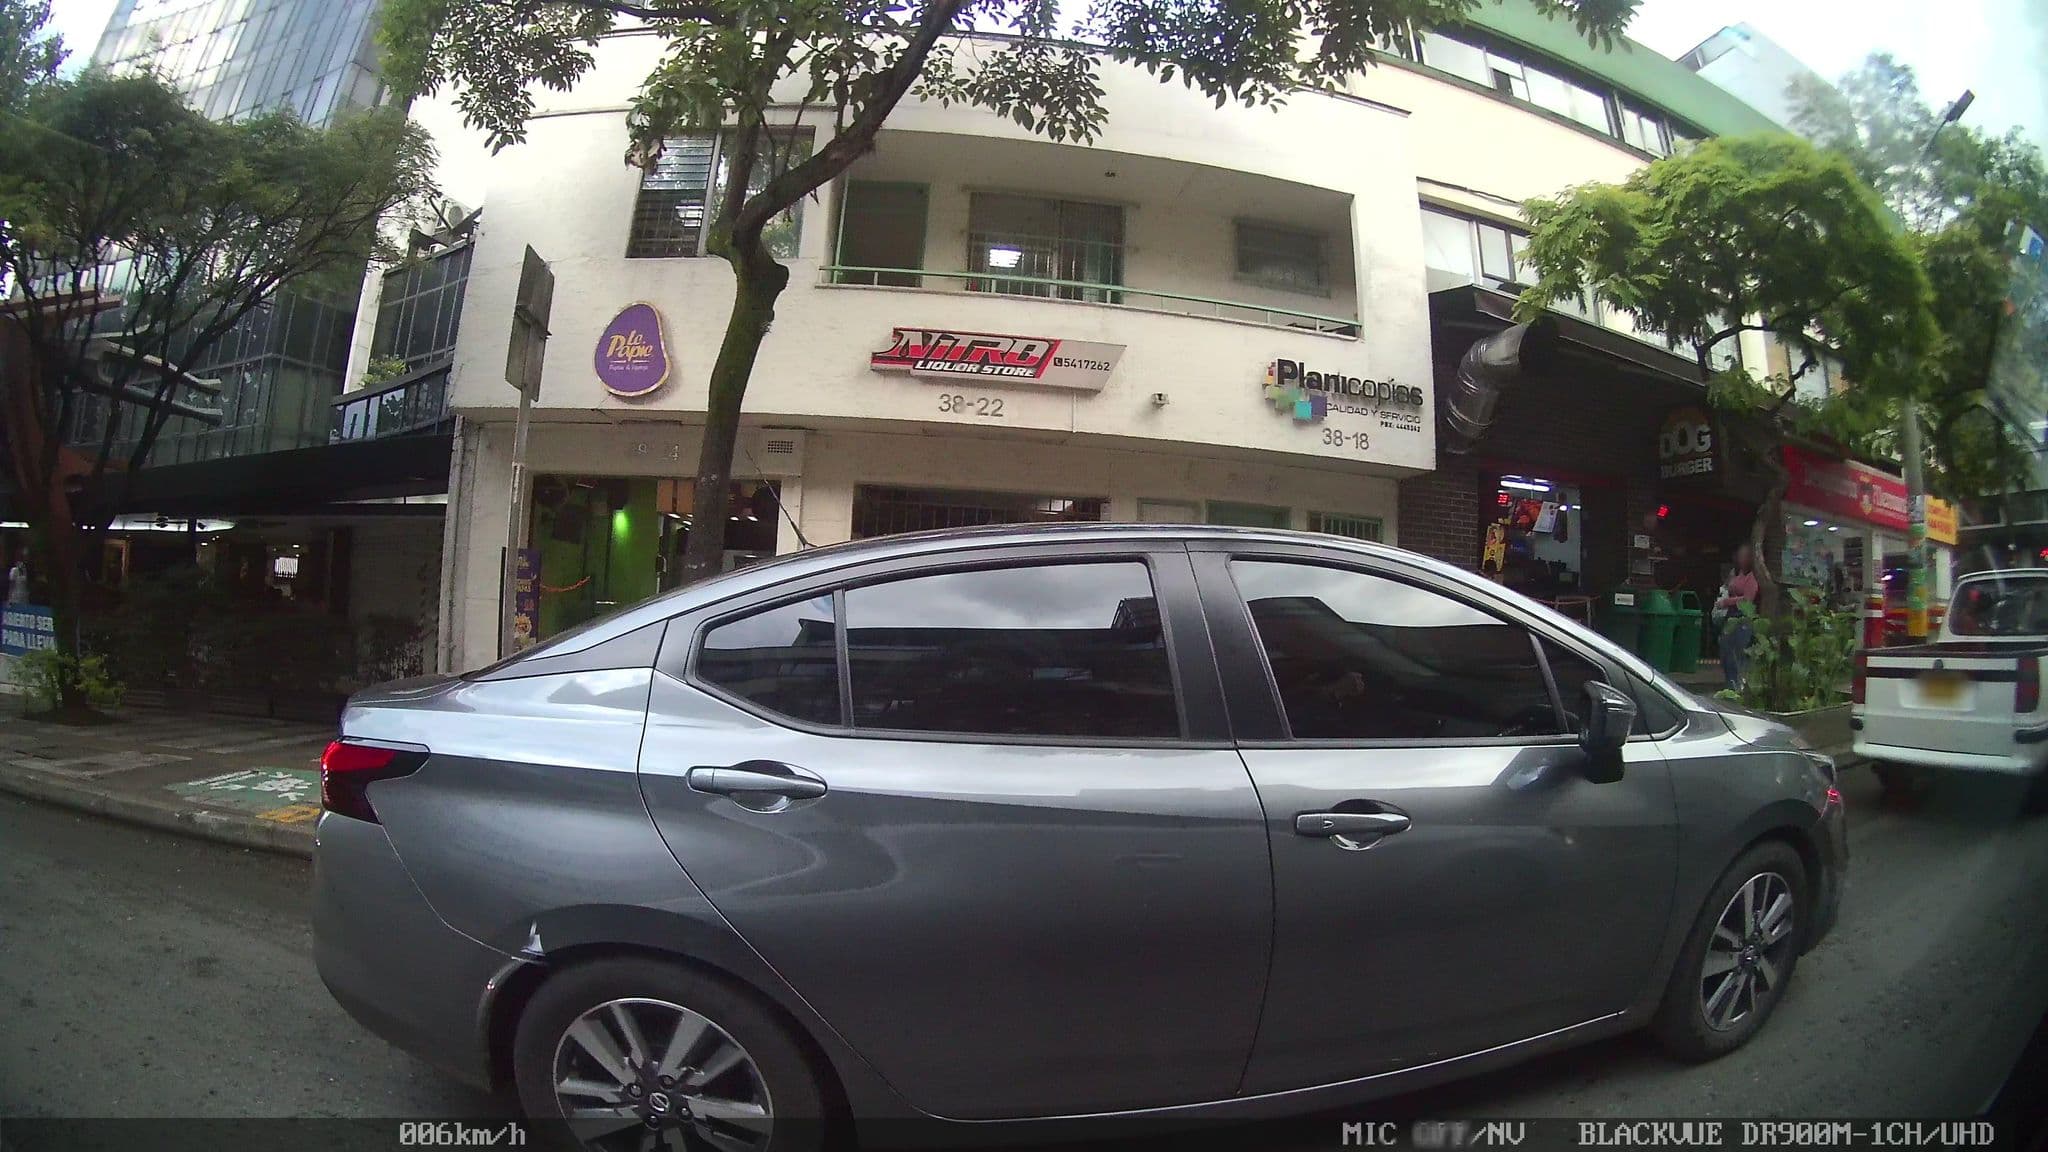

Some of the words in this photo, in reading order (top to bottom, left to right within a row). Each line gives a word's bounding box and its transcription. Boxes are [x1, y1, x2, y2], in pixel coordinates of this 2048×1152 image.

[914, 360, 979, 374] LIQUOR
[981, 365, 1036, 378] STORE
[1063, 357, 1111, 372] 5417262
[937, 393, 1004, 417] 38-22
[1326, 402, 1369, 416] CALIDAD
[1371, 408, 1378, 417] Y
[1380, 410, 1421, 424] SERVICIO
[1321, 427, 1370, 450] 38-18
[1659, 422, 1712, 457] DOG
